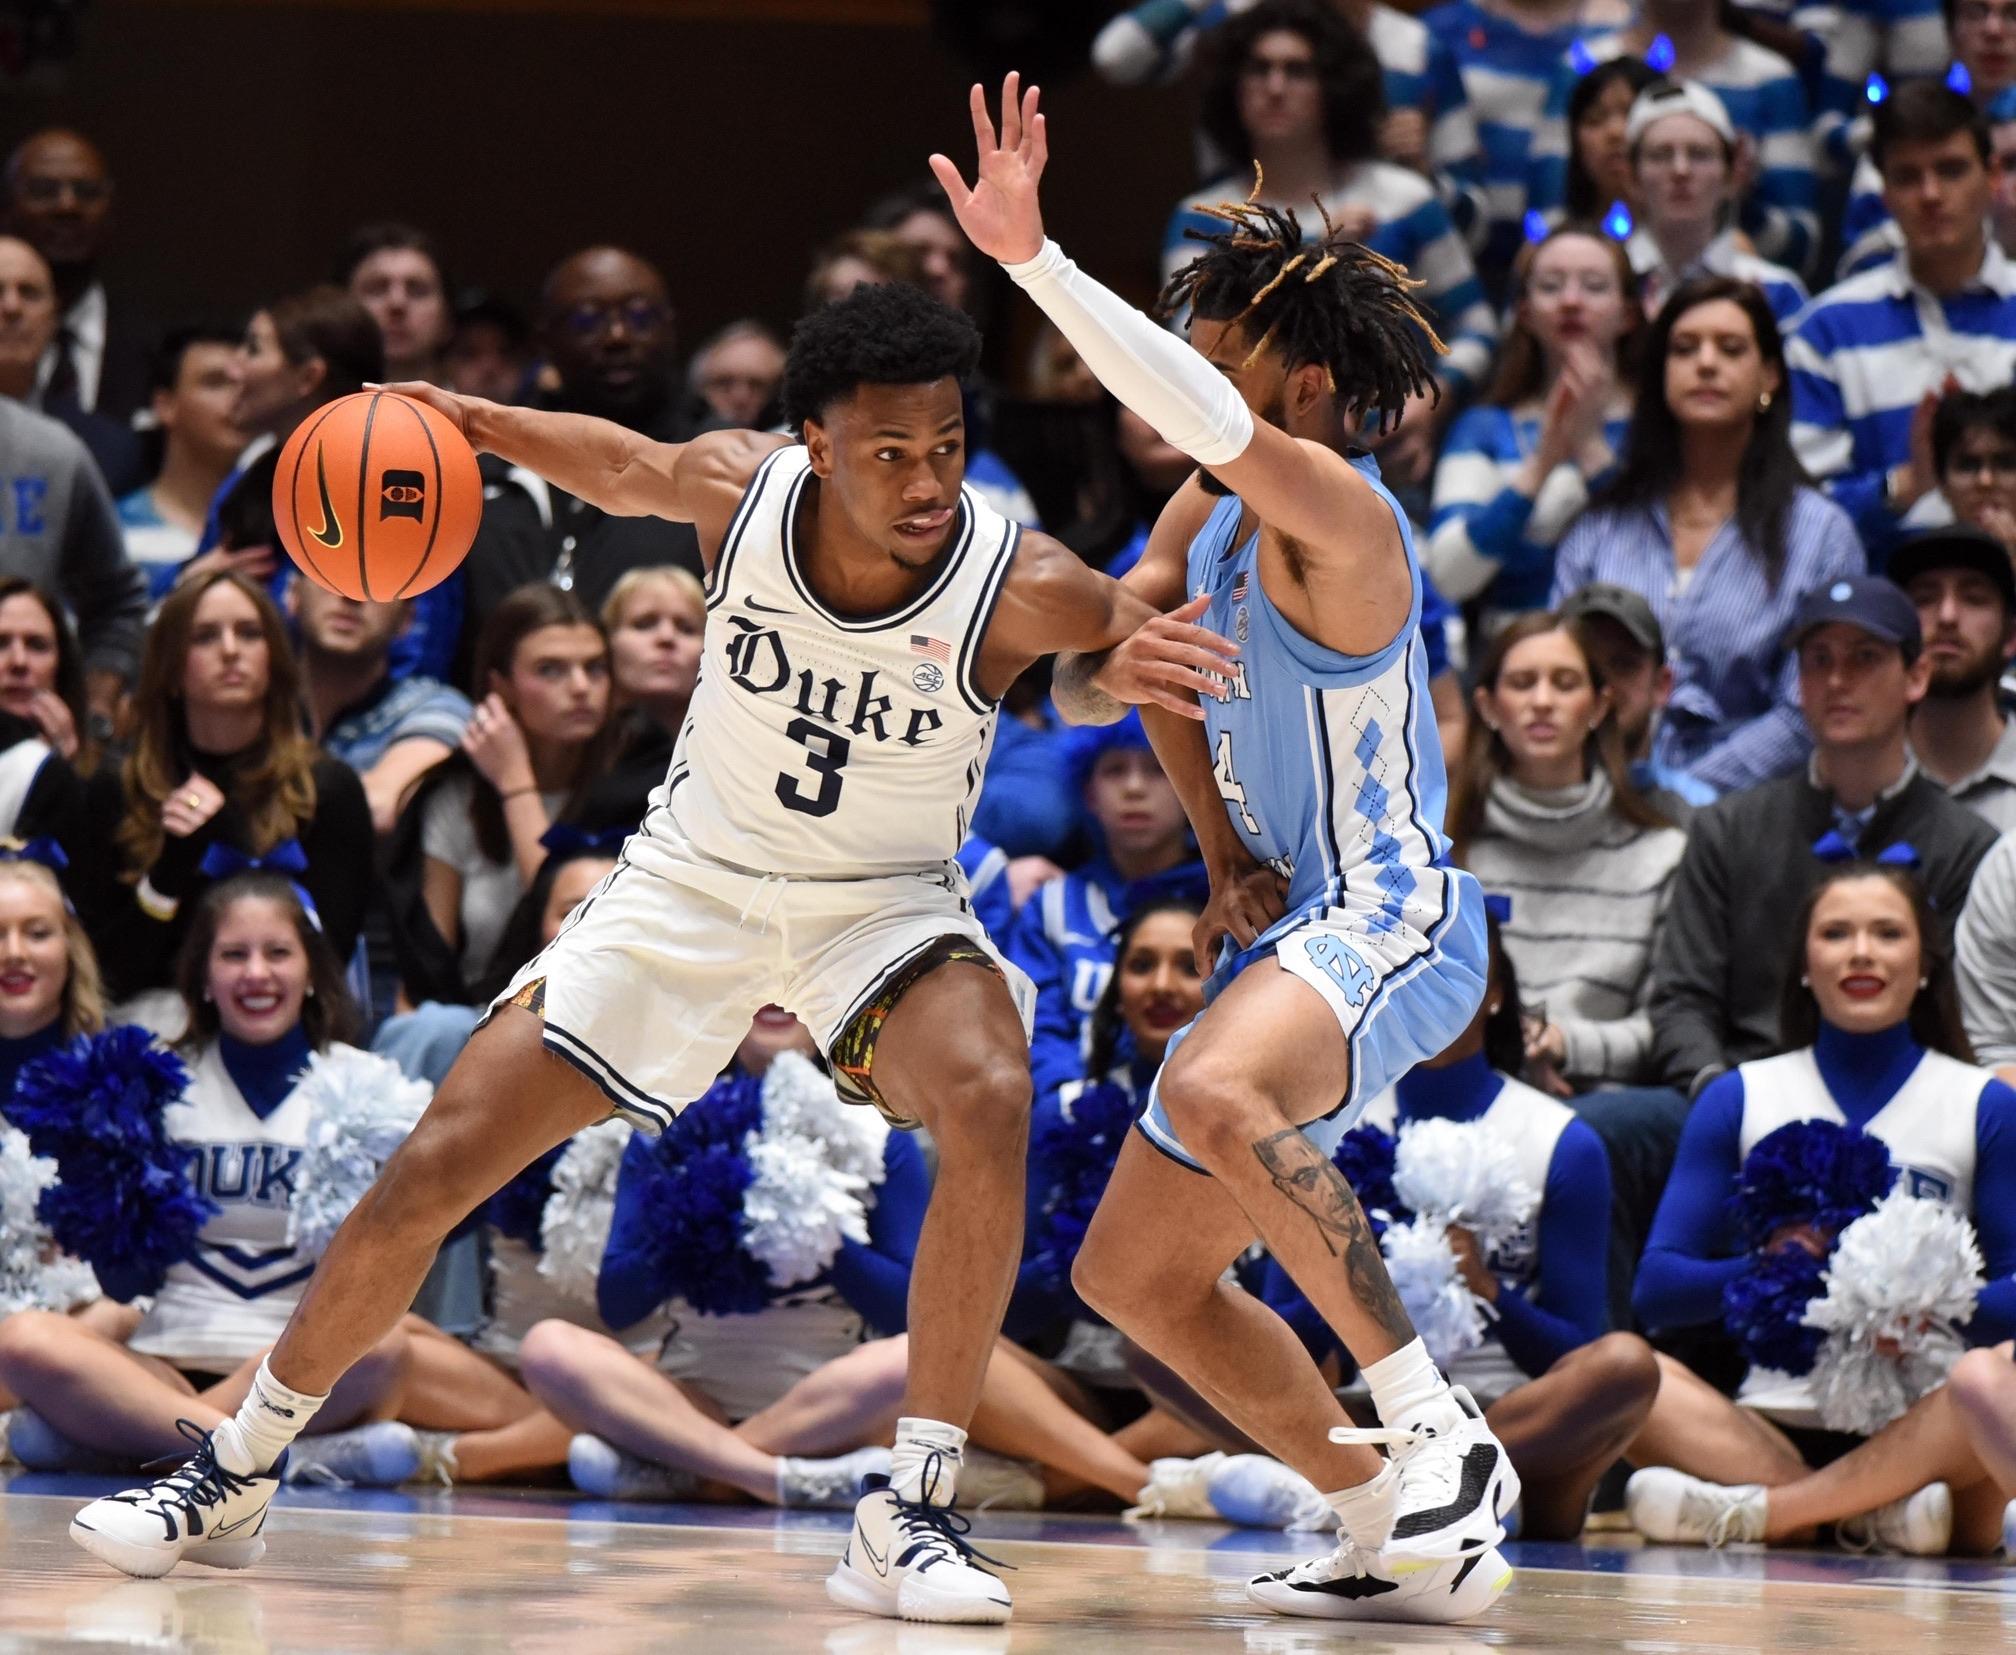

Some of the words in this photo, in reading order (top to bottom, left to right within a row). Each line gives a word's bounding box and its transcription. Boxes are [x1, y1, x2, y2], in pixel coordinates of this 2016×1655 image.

[725, 615, 943, 746] Duke
[775, 717, 851, 818] 3
[1213, 730, 1261, 836] 4
[193, 1143, 303, 1206] UK
